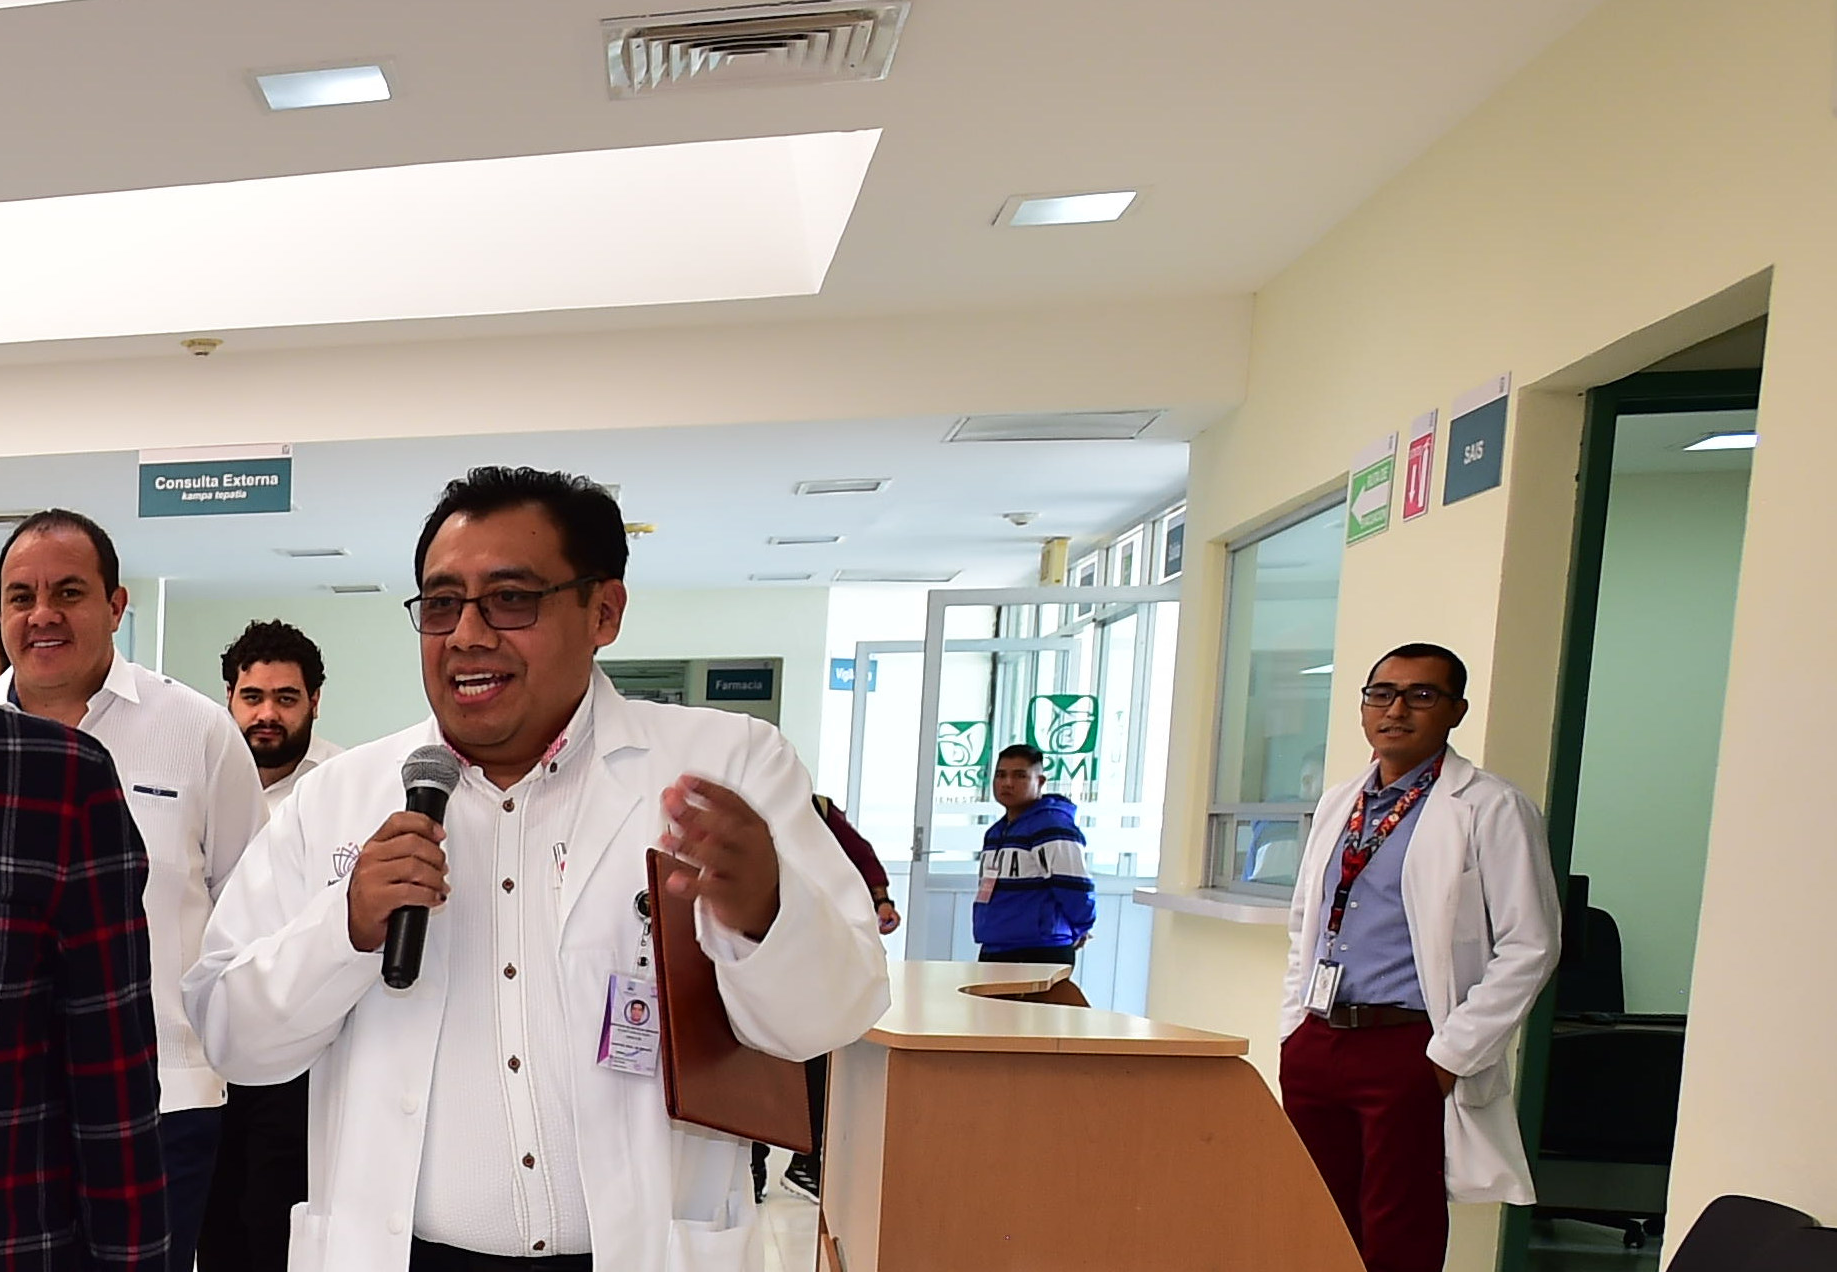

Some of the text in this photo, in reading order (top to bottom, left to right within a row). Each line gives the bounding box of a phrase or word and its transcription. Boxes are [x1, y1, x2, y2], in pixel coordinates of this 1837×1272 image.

[1464, 440, 1484, 465] SAIS
[155, 474, 279, 489] Consulta Externa
[715, 680, 762, 690] Farmacia
